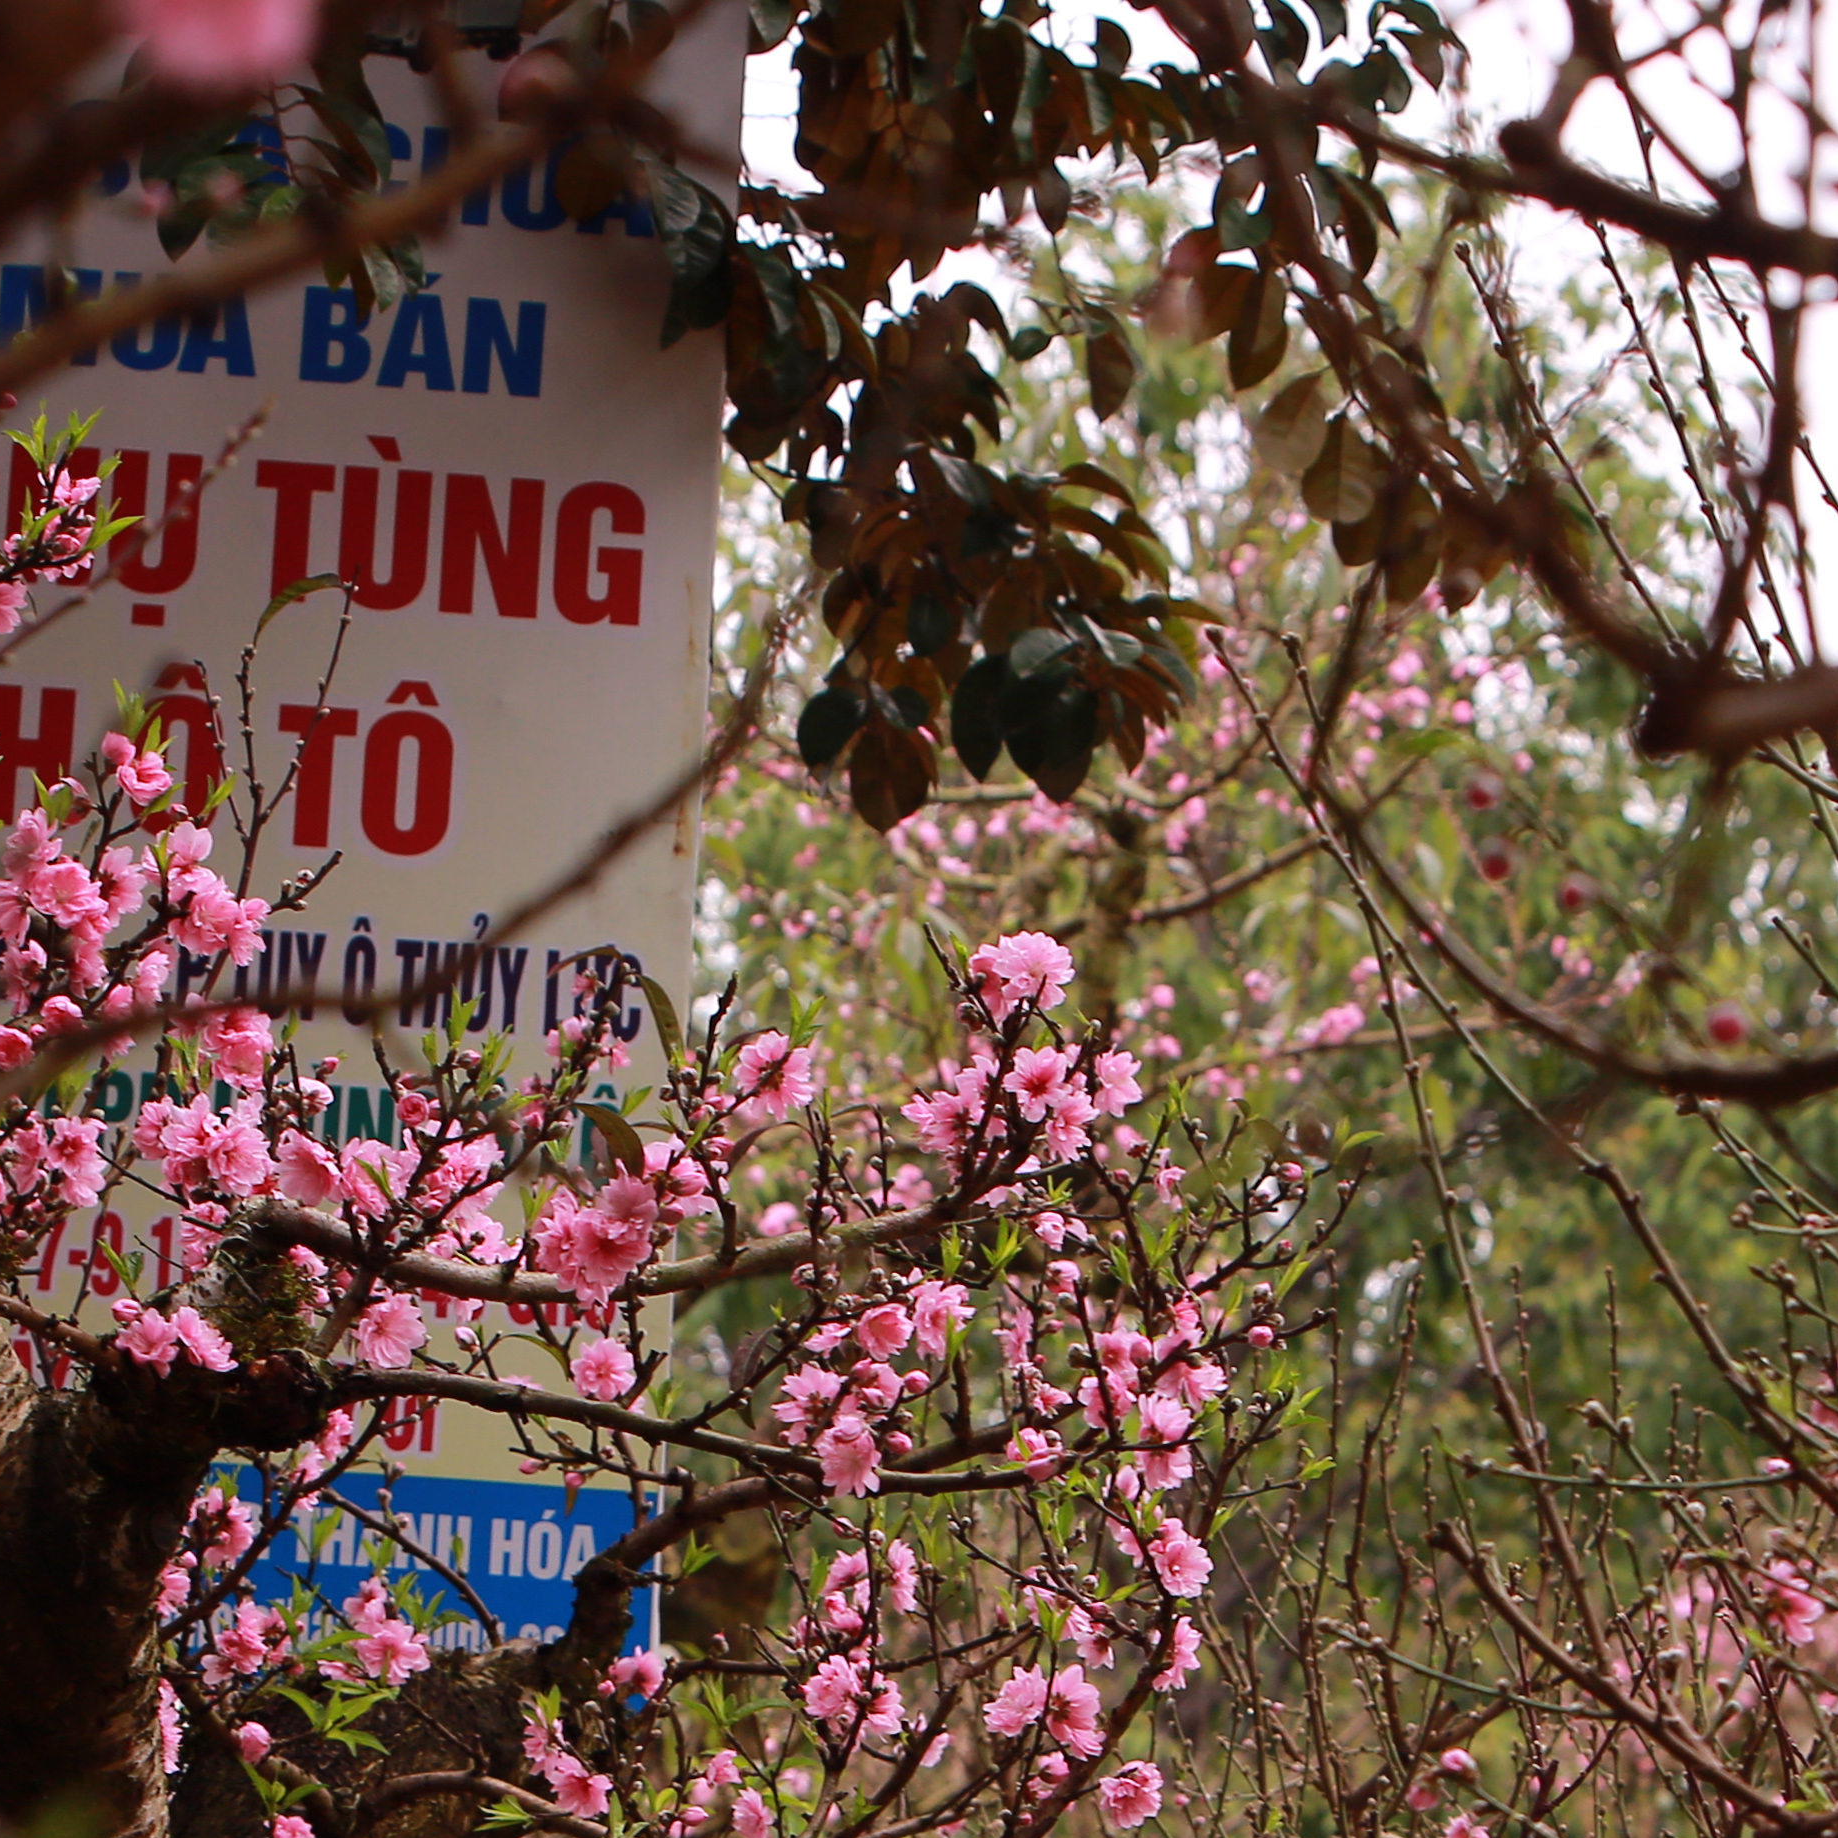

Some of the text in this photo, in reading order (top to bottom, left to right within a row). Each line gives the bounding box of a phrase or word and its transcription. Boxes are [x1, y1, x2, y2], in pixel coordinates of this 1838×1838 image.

[298, 272, 547, 399] BÁN
[256, 434, 646, 627] TÙNG
[137, 662, 224, 836] Ô
[278, 680, 454, 857] TÔ
[488, 1509, 599, 1582] HÓA
